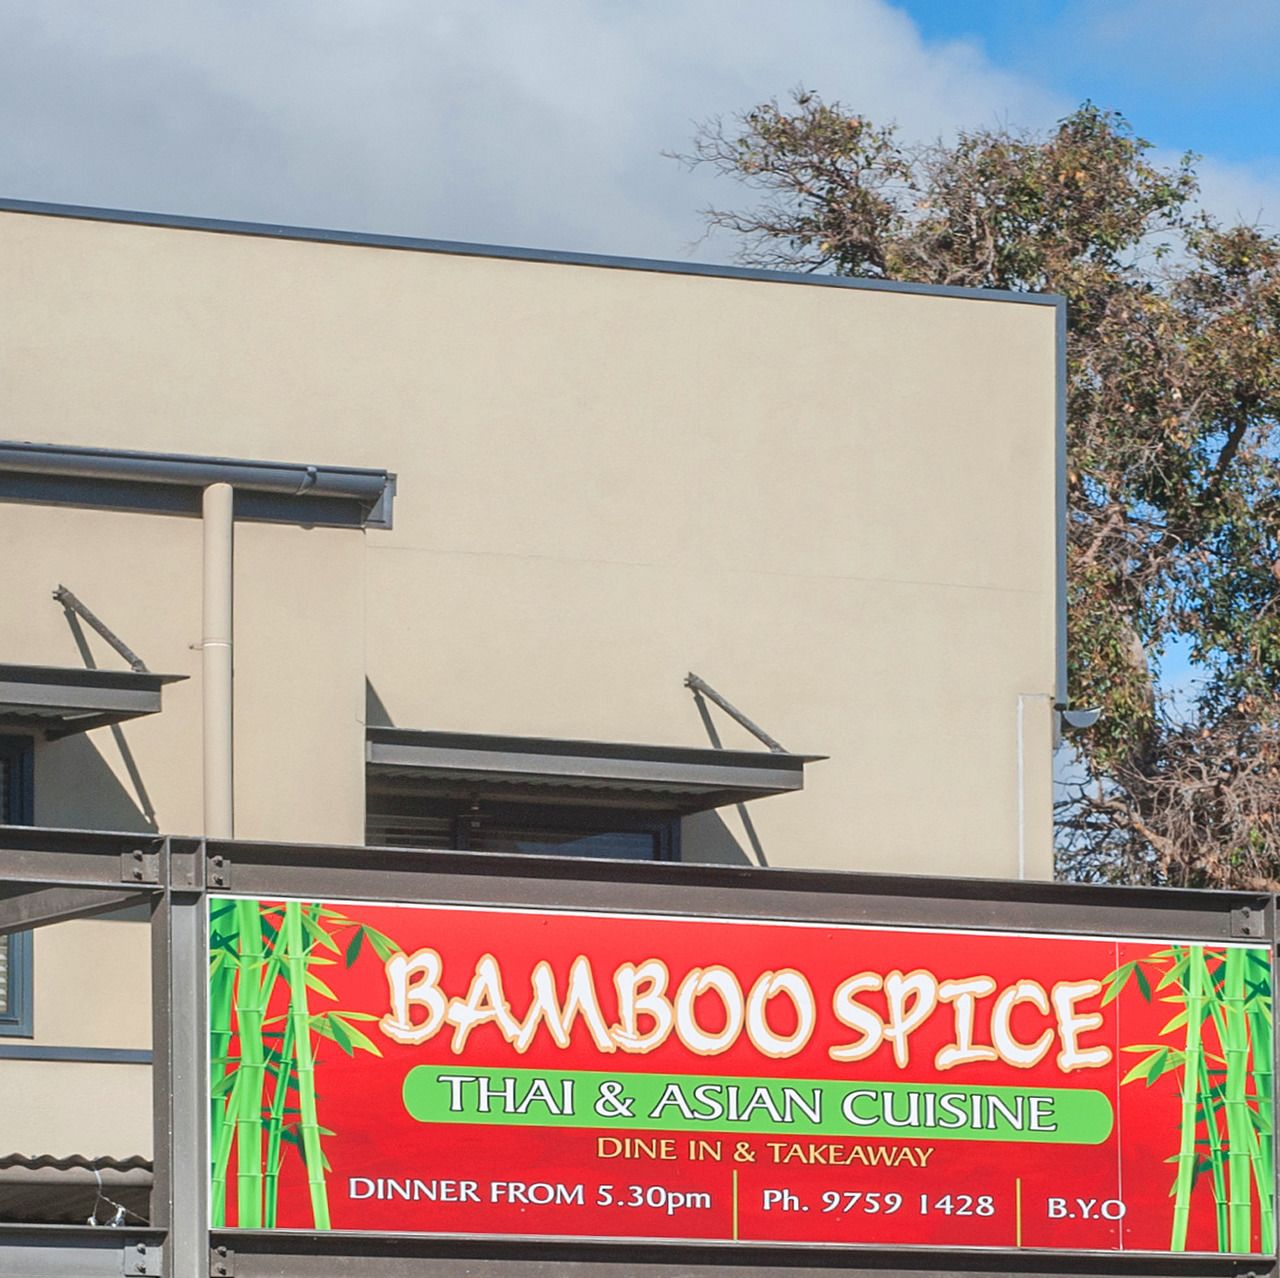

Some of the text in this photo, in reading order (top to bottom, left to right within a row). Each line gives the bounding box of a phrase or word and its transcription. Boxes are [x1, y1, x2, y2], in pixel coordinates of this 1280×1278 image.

[379, 947, 1114, 1072] BAMBOO SPICE
[437, 1074, 1057, 1133] THAI & ASIAN CUISINE
[596, 1136, 935, 1169] DINE IN & TAKEAWAY
[348, 1176, 712, 1217] DINNER FROM 5.30pm
[762, 1188, 996, 1218] Ph. 9759 1428
